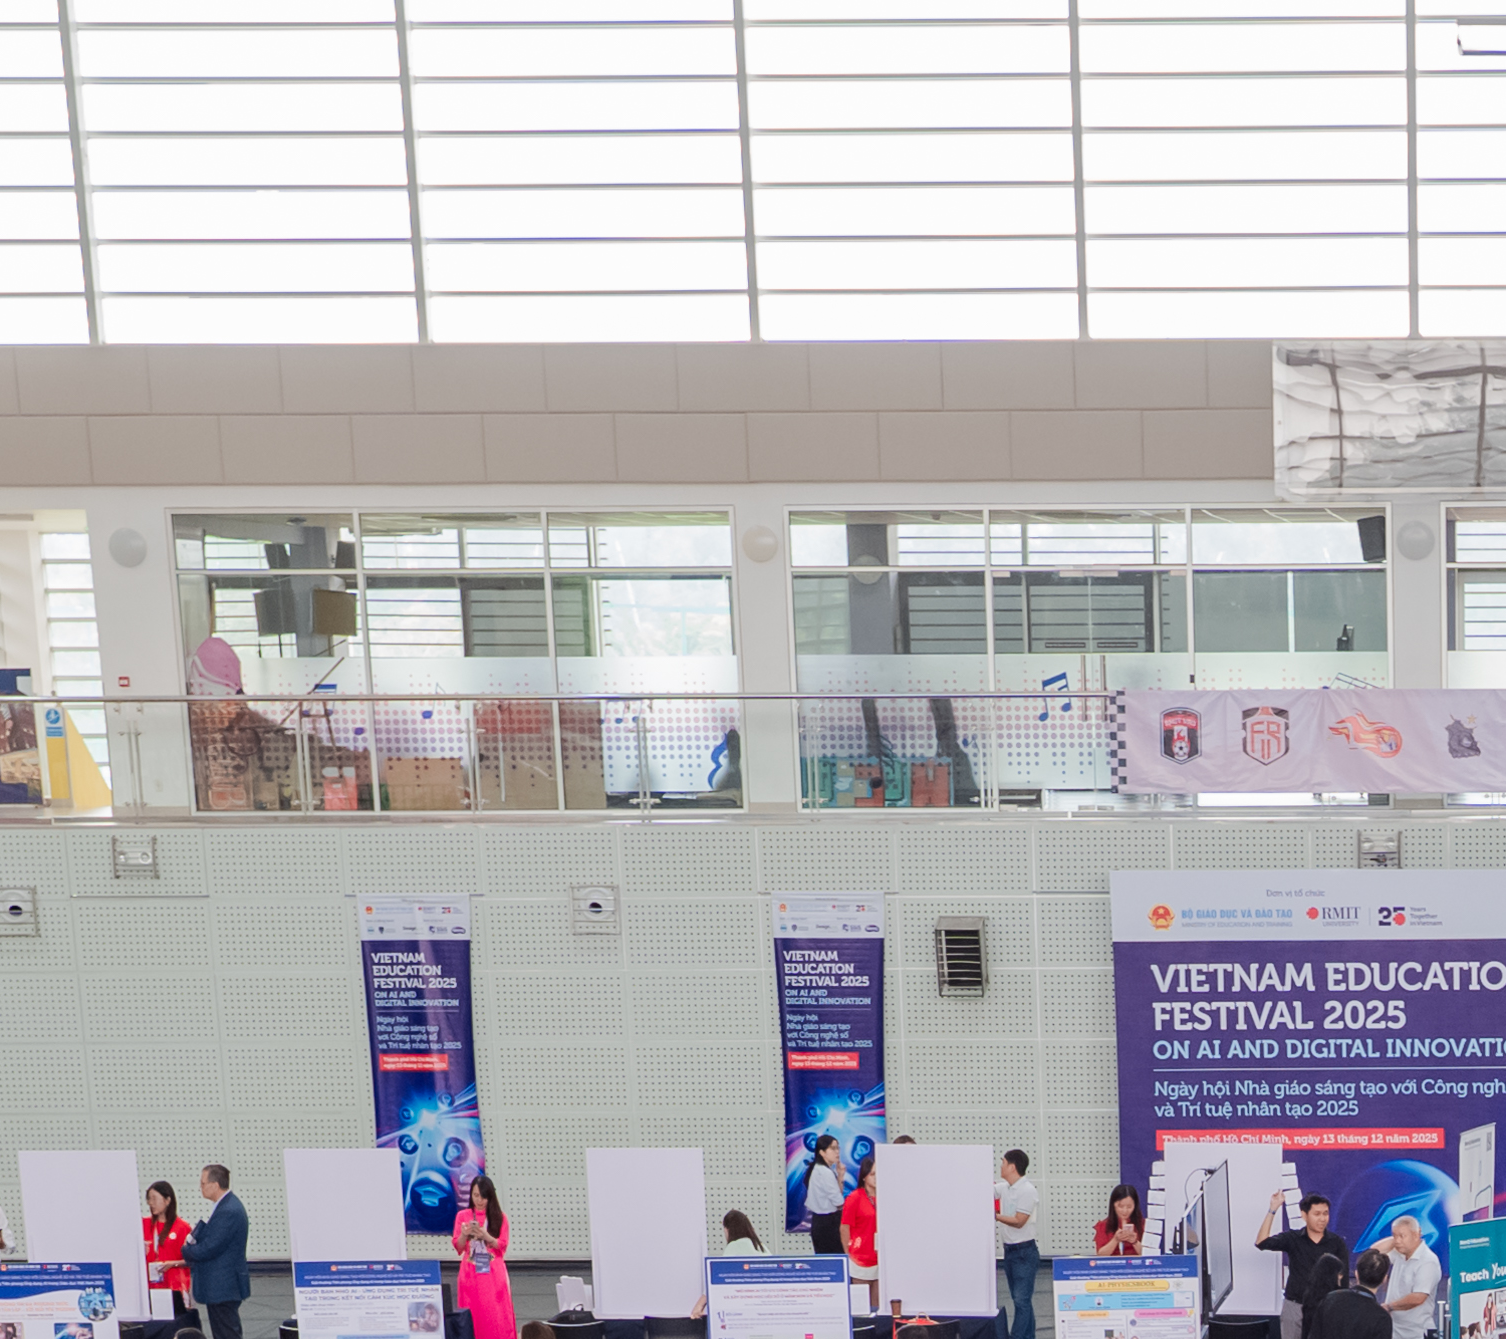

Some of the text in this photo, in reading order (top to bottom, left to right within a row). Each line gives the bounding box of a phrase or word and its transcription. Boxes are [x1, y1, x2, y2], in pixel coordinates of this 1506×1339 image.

[1322, 906, 1361, 920] RMIT
[371, 952, 426, 964] VIETNAM
[783, 950, 838, 962] VIETNAM
[372, 965, 442, 976] EDUCATION
[784, 963, 854, 974] EDUCATION
[374, 978, 457, 988] FESTIVAL 2025
[785, 976, 870, 986] FESTIVAL 2025
[1150, 962, 1316, 992] VIETNAM
[1152, 1000, 1407, 1031] FESTIVAL 2025
[1152, 1040, 1190, 1060] ON
[1196, 1040, 1221, 1059] AI
[1227, 1040, 1280, 1059] AND
[1286, 1039, 1380, 1059] DIGITAL
[1154, 1080, 1198, 1098] Ngày
[1203, 1080, 1230, 1097] hội
[1234, 1080, 1270, 1096] Nhà
[1274, 1080, 1311, 1099] giáo
[1315, 1080, 1355, 1098] sáng
[1359, 1082, 1388, 1098] tạo
[1392, 1079, 1418, 1094] với
[1421, 1076, 1468, 1098] Công
[1154, 1100, 1359, 1120] và Trí tuệ nhân tạo 2025
[1460, 1268, 1490, 1283] Teach
